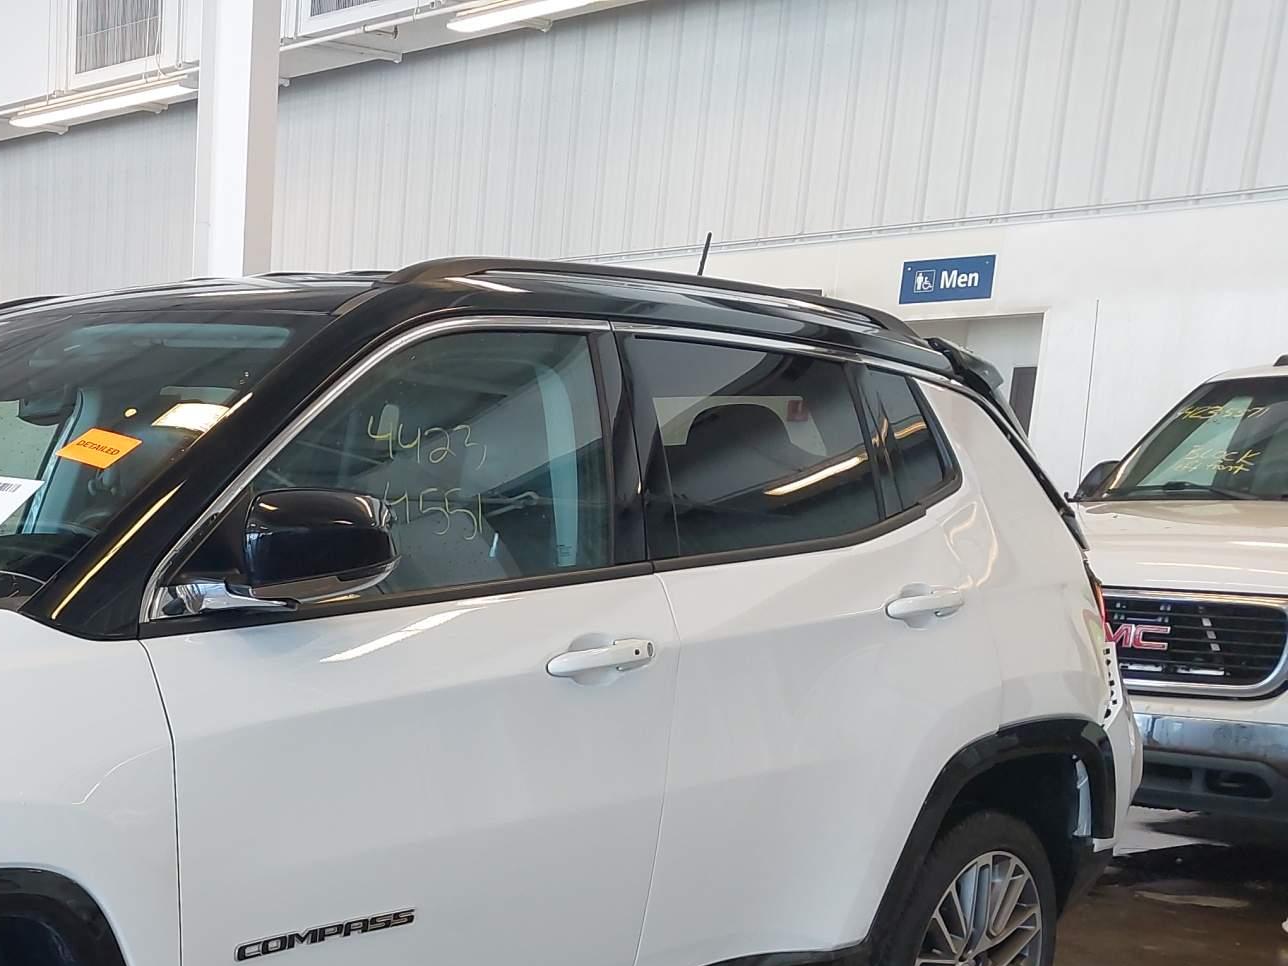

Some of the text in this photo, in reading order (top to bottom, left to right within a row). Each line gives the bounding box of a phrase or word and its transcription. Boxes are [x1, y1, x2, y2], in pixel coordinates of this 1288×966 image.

[940, 270, 979, 289] Men
[76, 440, 121, 456] DETAILED
[384, 481, 484, 541] 4551
[1103, 622, 1171, 651] MC
[235, 907, 416, 962] COMPASS
